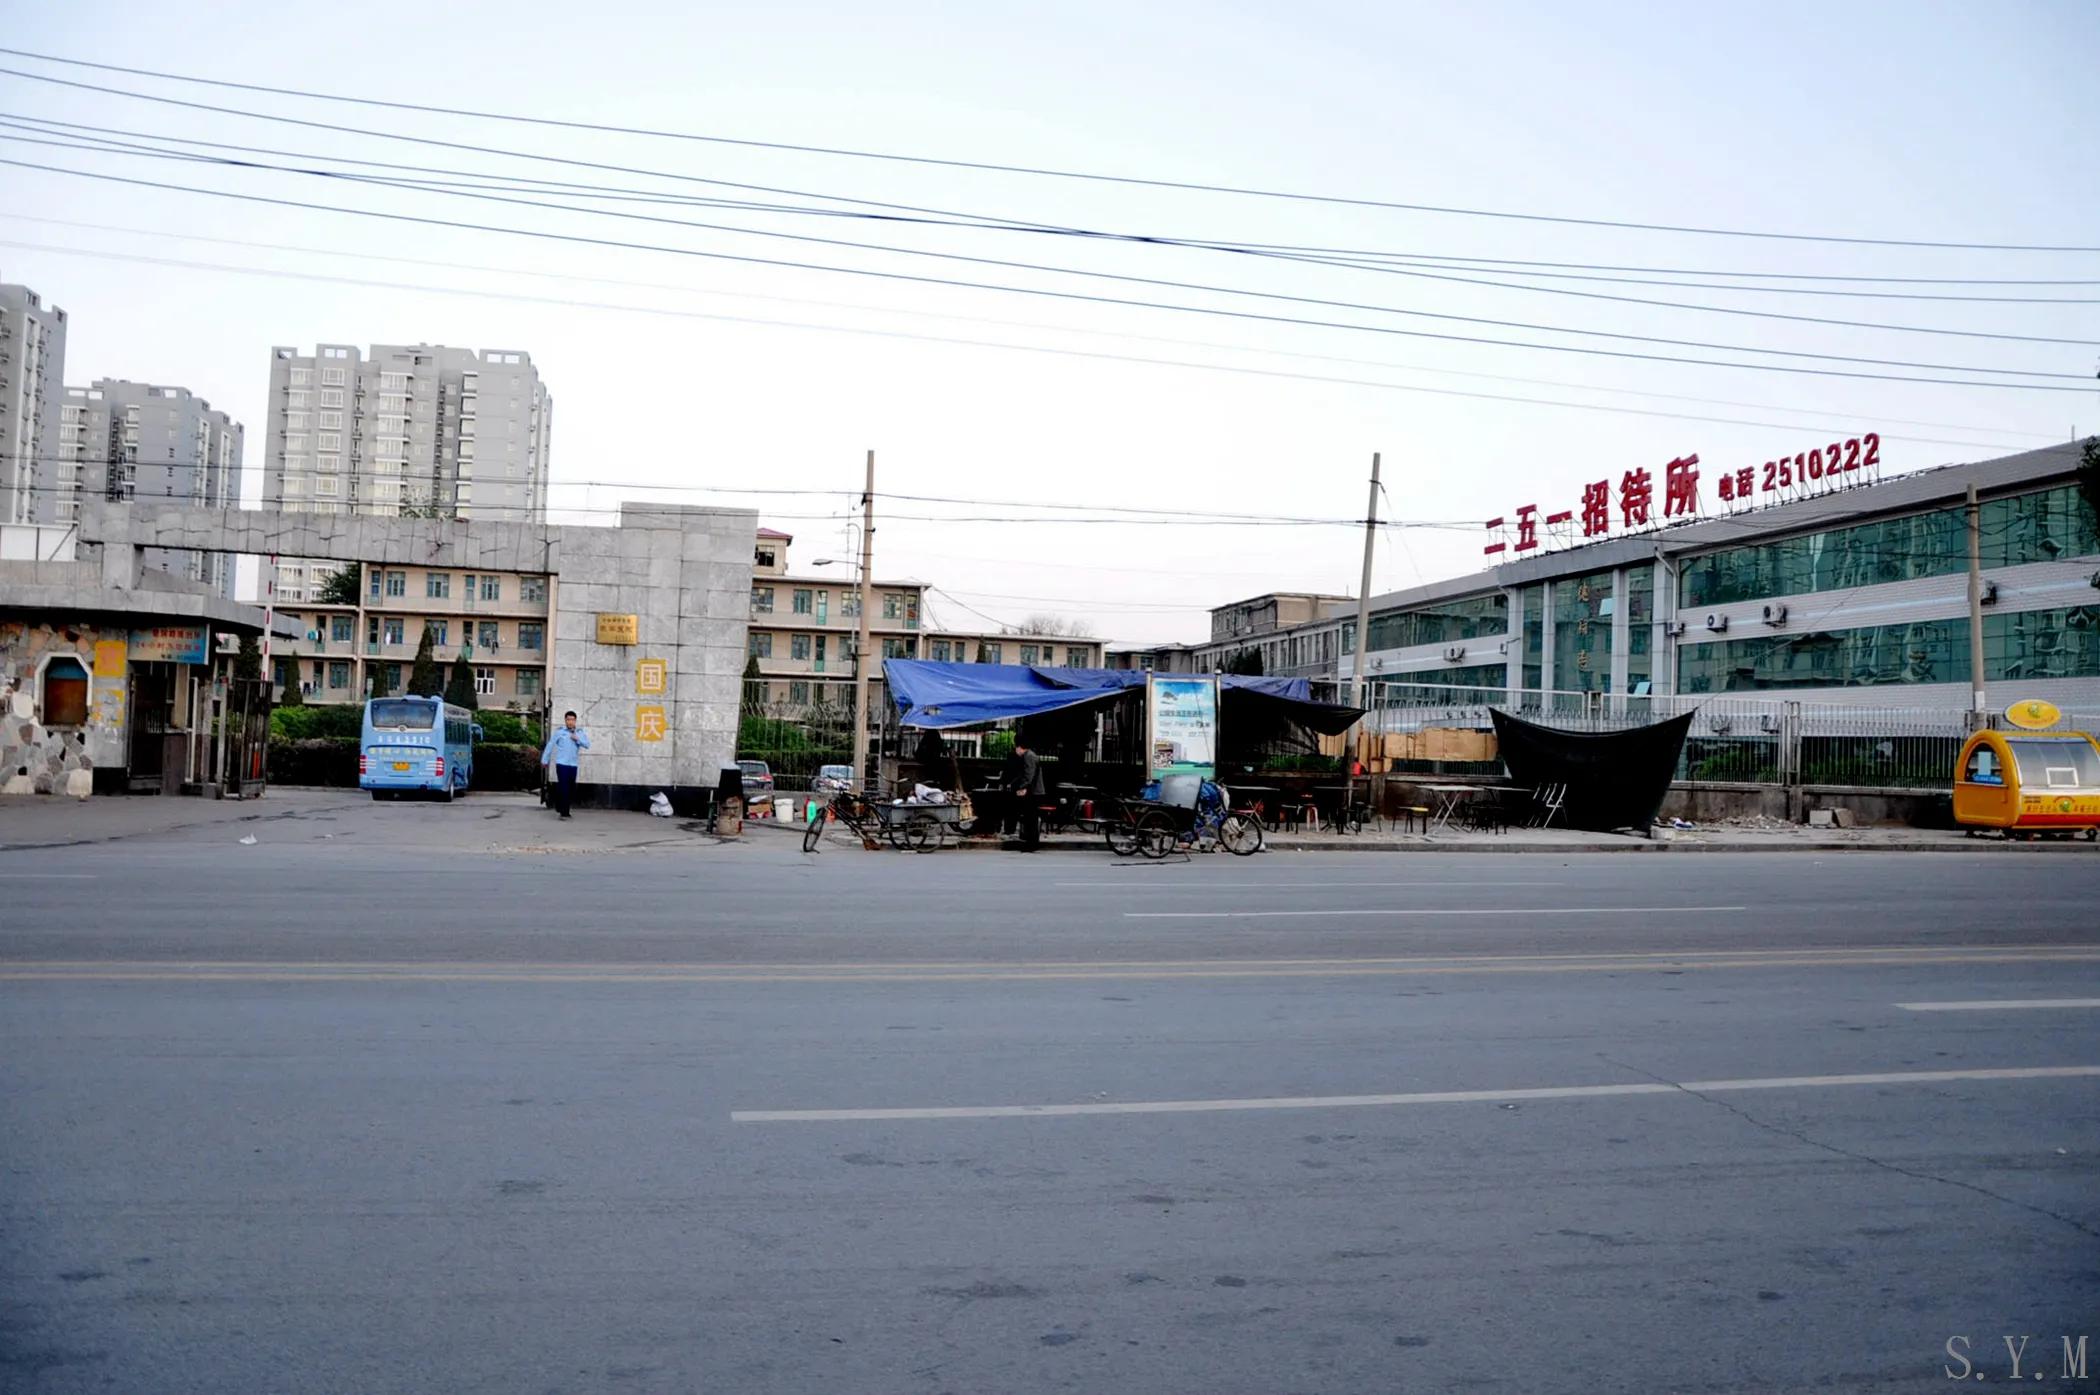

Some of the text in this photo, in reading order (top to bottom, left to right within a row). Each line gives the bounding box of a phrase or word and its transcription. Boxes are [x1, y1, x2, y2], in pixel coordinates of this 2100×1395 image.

[1484, 432, 1880, 554] 二五一招待所 电话 2510222
